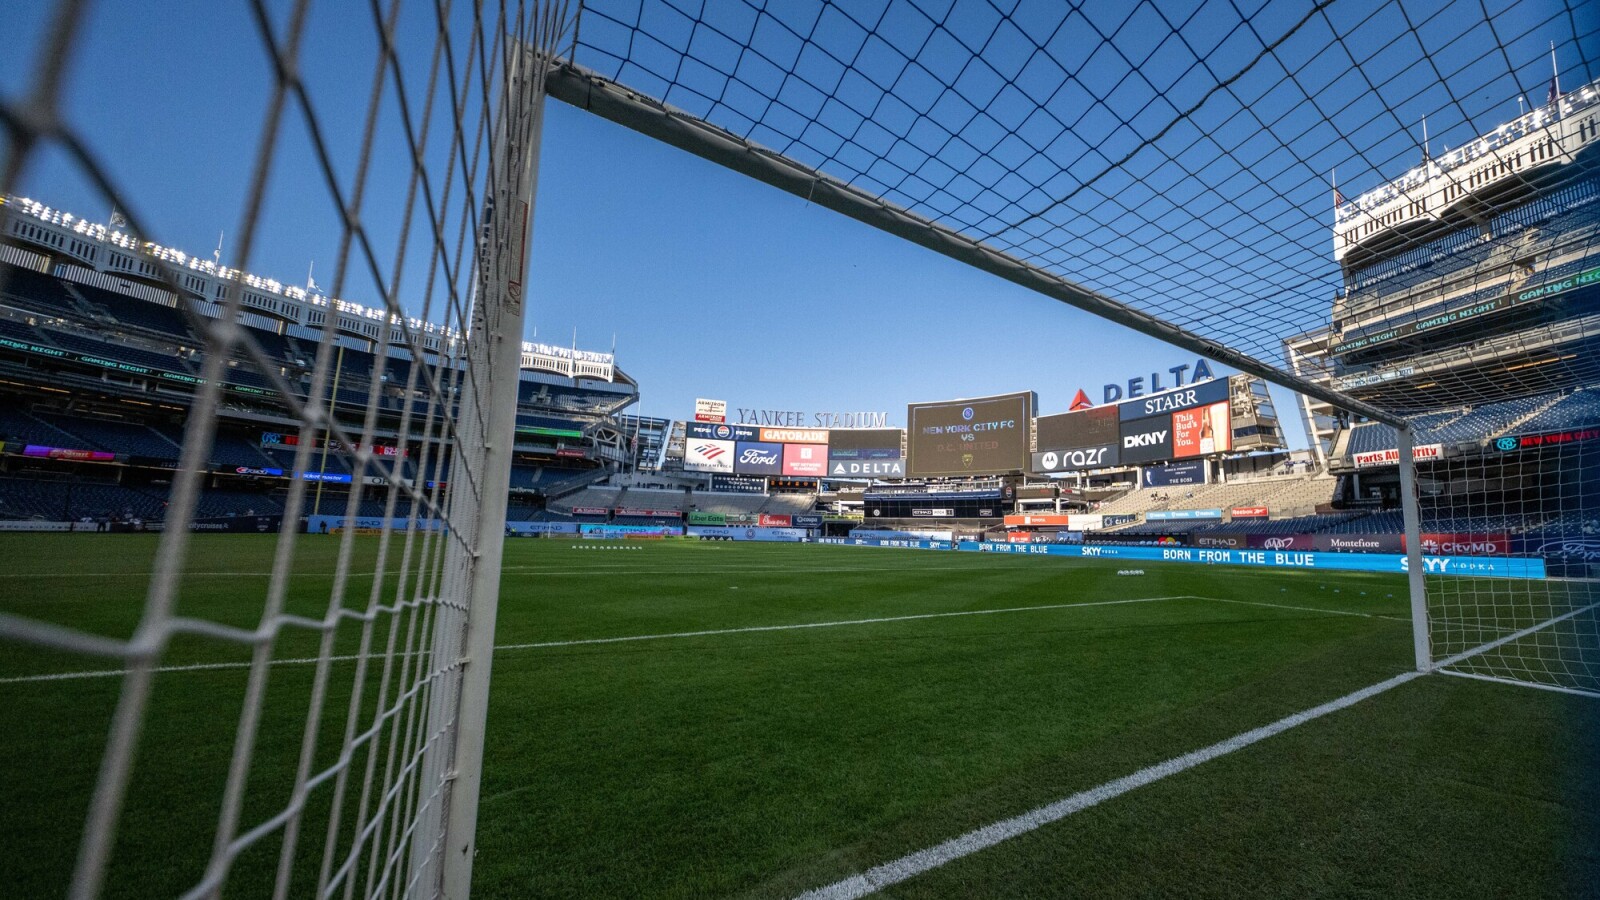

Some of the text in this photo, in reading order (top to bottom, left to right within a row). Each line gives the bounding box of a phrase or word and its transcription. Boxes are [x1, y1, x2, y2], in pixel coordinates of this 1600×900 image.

[1519, 268, 1600, 301] GAMING NIG
[1415, 302, 1496, 331] GAMING NIGHT
[1335, 329, 1398, 352] GAMING NIGHT
[0, 339, 65, 356] MING NIGHT
[81, 356, 148, 374] GAMING NIGHT
[163, 372, 196, 383] GAMING
[1104, 358, 1214, 404] DELTA
[1145, 389, 1198, 414] STARR
[737, 408, 888, 428] YANKEE STADIUM
[1175, 413, 1193, 423] This
[923, 420, 1015, 435] NEW YORK CITY FC
[1176, 420, 1198, 430] Bud's
[764, 430, 825, 441] GATORADE
[961, 433, 975, 441] VS
[1124, 430, 1167, 448] DKNY
[1176, 430, 1190, 438] For
[1521, 435, 1543, 446] NEW
[1545, 432, 1573, 444] YORK
[1574, 430, 1600, 440] CITY
[959, 441, 998, 451] UNITED
[1176, 438, 1194, 447] You.
[739, 448, 778, 465] Ford
[1063, 447, 1108, 467] razr
[1357, 453, 1384, 463] Parts
[850, 463, 902, 473] DELTA
[909, 540, 920, 548] BLUE
[1198, 537, 1237, 546] ETIHAD
[1330, 538, 1380, 548] Montefiore
[979, 543, 993, 551] BORN
[1030, 545, 1048, 554] BLUE
[1081, 546, 1102, 556] SKYY
[1441, 542, 1497, 553] CityMD
[1163, 549, 1315, 566] BORN FROM THE BLUE
[1400, 556, 1495, 572] SYY VODKA
